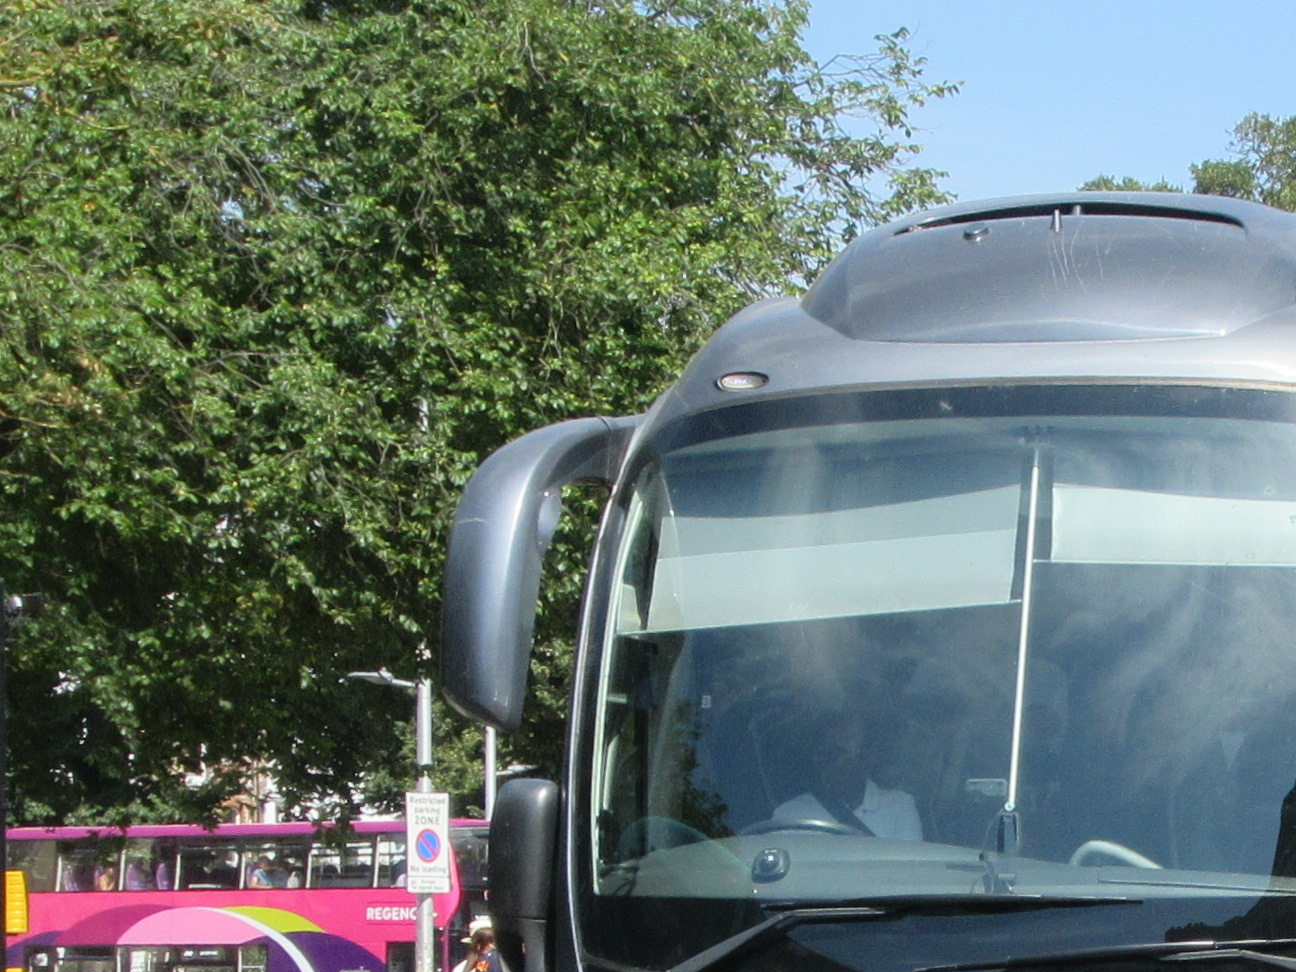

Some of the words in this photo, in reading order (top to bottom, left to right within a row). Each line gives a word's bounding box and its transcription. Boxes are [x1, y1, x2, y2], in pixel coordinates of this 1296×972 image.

[410, 796, 446, 804] Restricted
[414, 807, 440, 815] parking
[415, 816, 440, 825] ZONE
[422, 865, 446, 873] loading
[366, 907, 430, 920] REGENC
